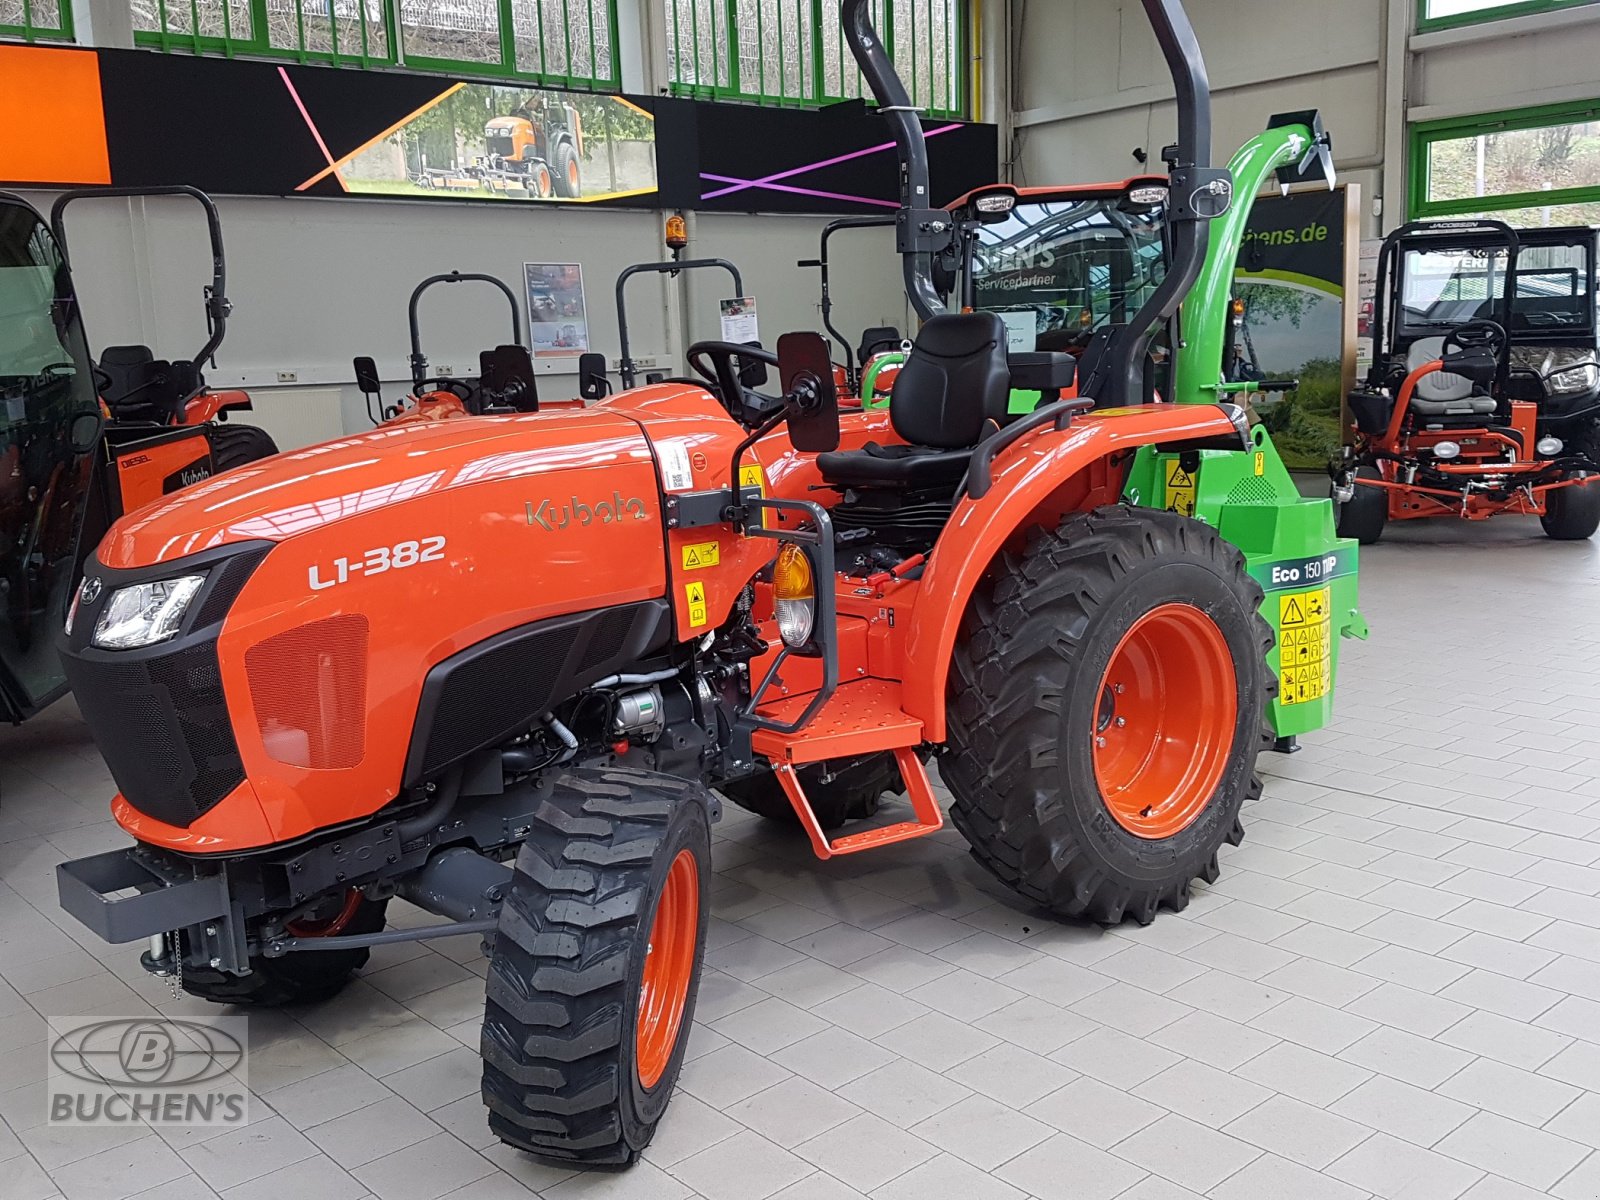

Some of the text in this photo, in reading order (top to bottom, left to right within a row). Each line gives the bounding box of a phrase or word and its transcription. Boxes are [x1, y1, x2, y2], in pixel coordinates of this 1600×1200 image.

[1429, 221, 1478, 229] JACOBSEN
[977, 275, 1056, 291] Servicepartner
[121, 455, 152, 469] DIESEL
[181, 466, 209, 486] Kubota
[525, 490, 646, 531] Kubota
[308, 535, 446, 590] L1-382
[1272, 566, 1300, 583] Eco
[1304, 561, 1321, 579] 150
